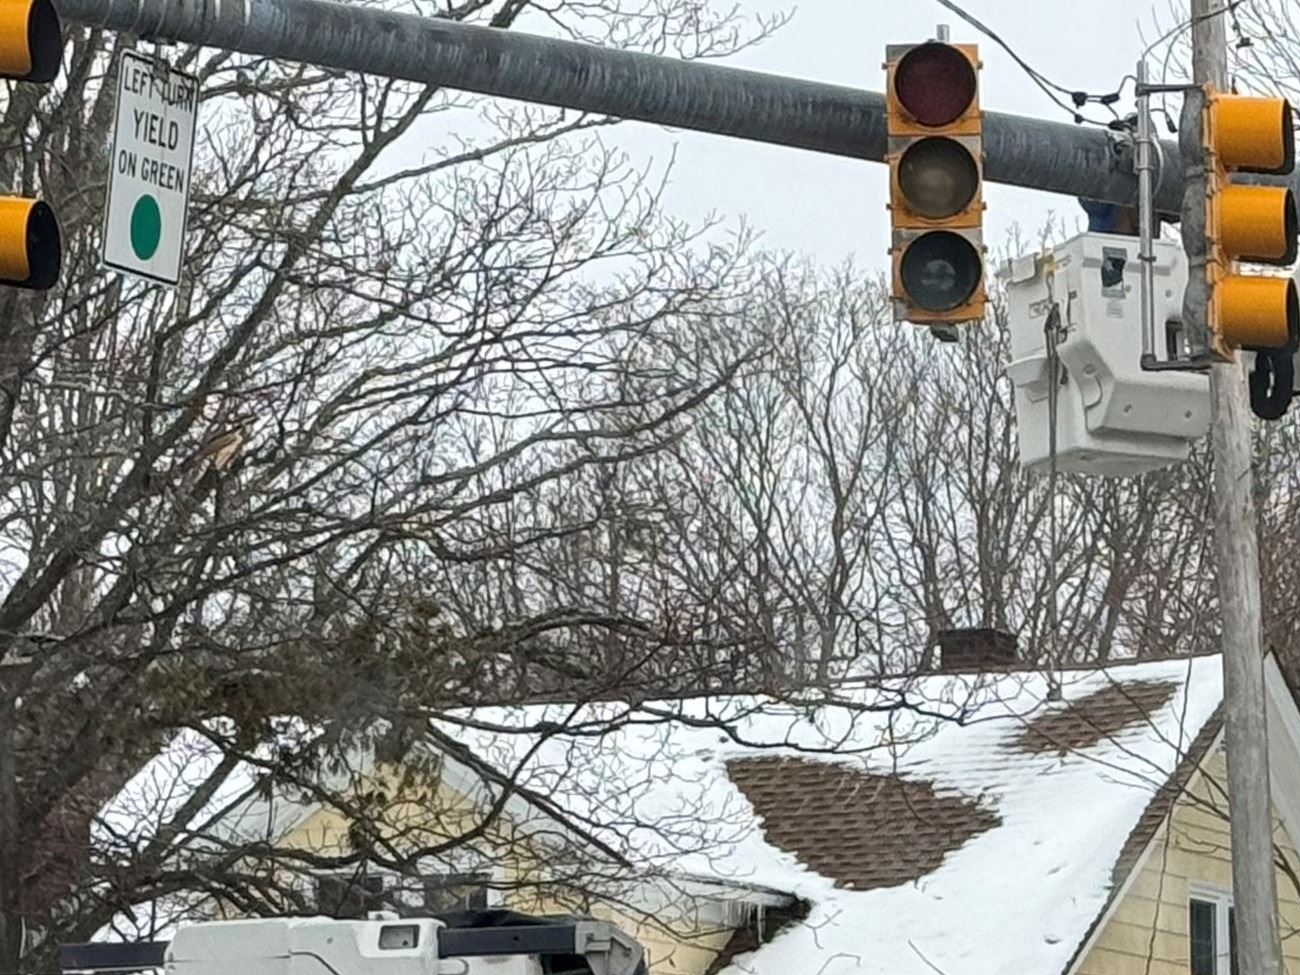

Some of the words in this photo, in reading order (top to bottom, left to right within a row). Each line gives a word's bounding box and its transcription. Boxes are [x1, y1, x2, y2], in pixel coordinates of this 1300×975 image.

[124, 65, 155, 99] LEFT
[133, 108, 179, 150] YIELD
[118, 150, 137, 178] ON
[141, 157, 184, 193] GREEN
